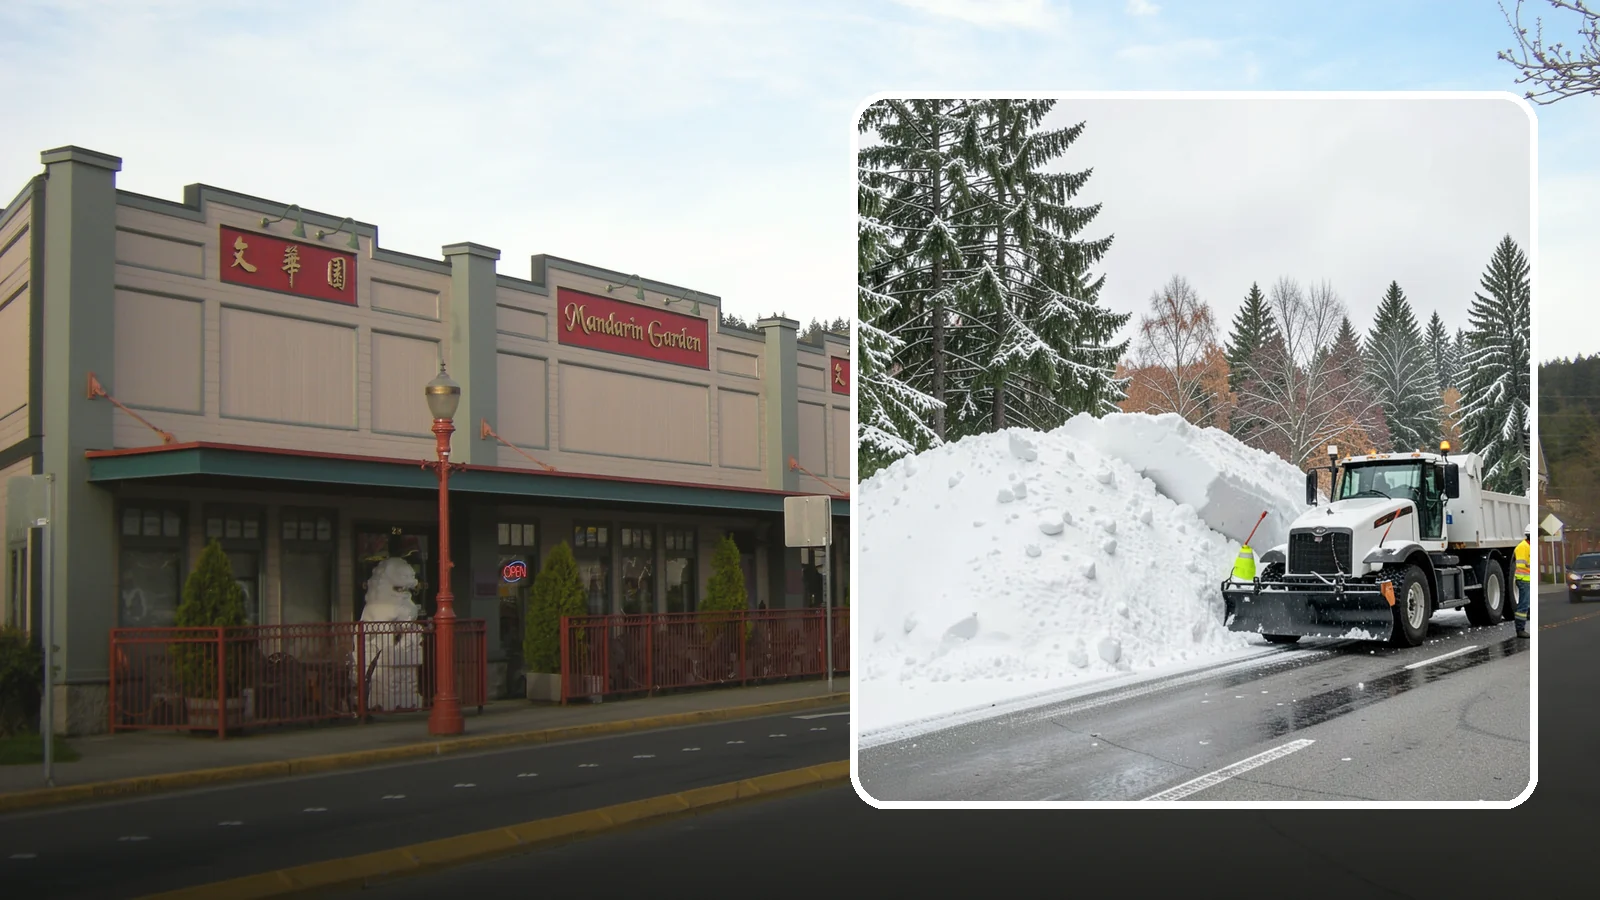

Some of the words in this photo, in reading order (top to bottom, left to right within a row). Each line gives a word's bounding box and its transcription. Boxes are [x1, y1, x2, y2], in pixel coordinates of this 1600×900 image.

[230, 235, 346, 291] 文華園
[564, 302, 644, 342] Mandarin
[647, 320, 702, 352] Garden
[503, 565, 527, 578] OPEN
